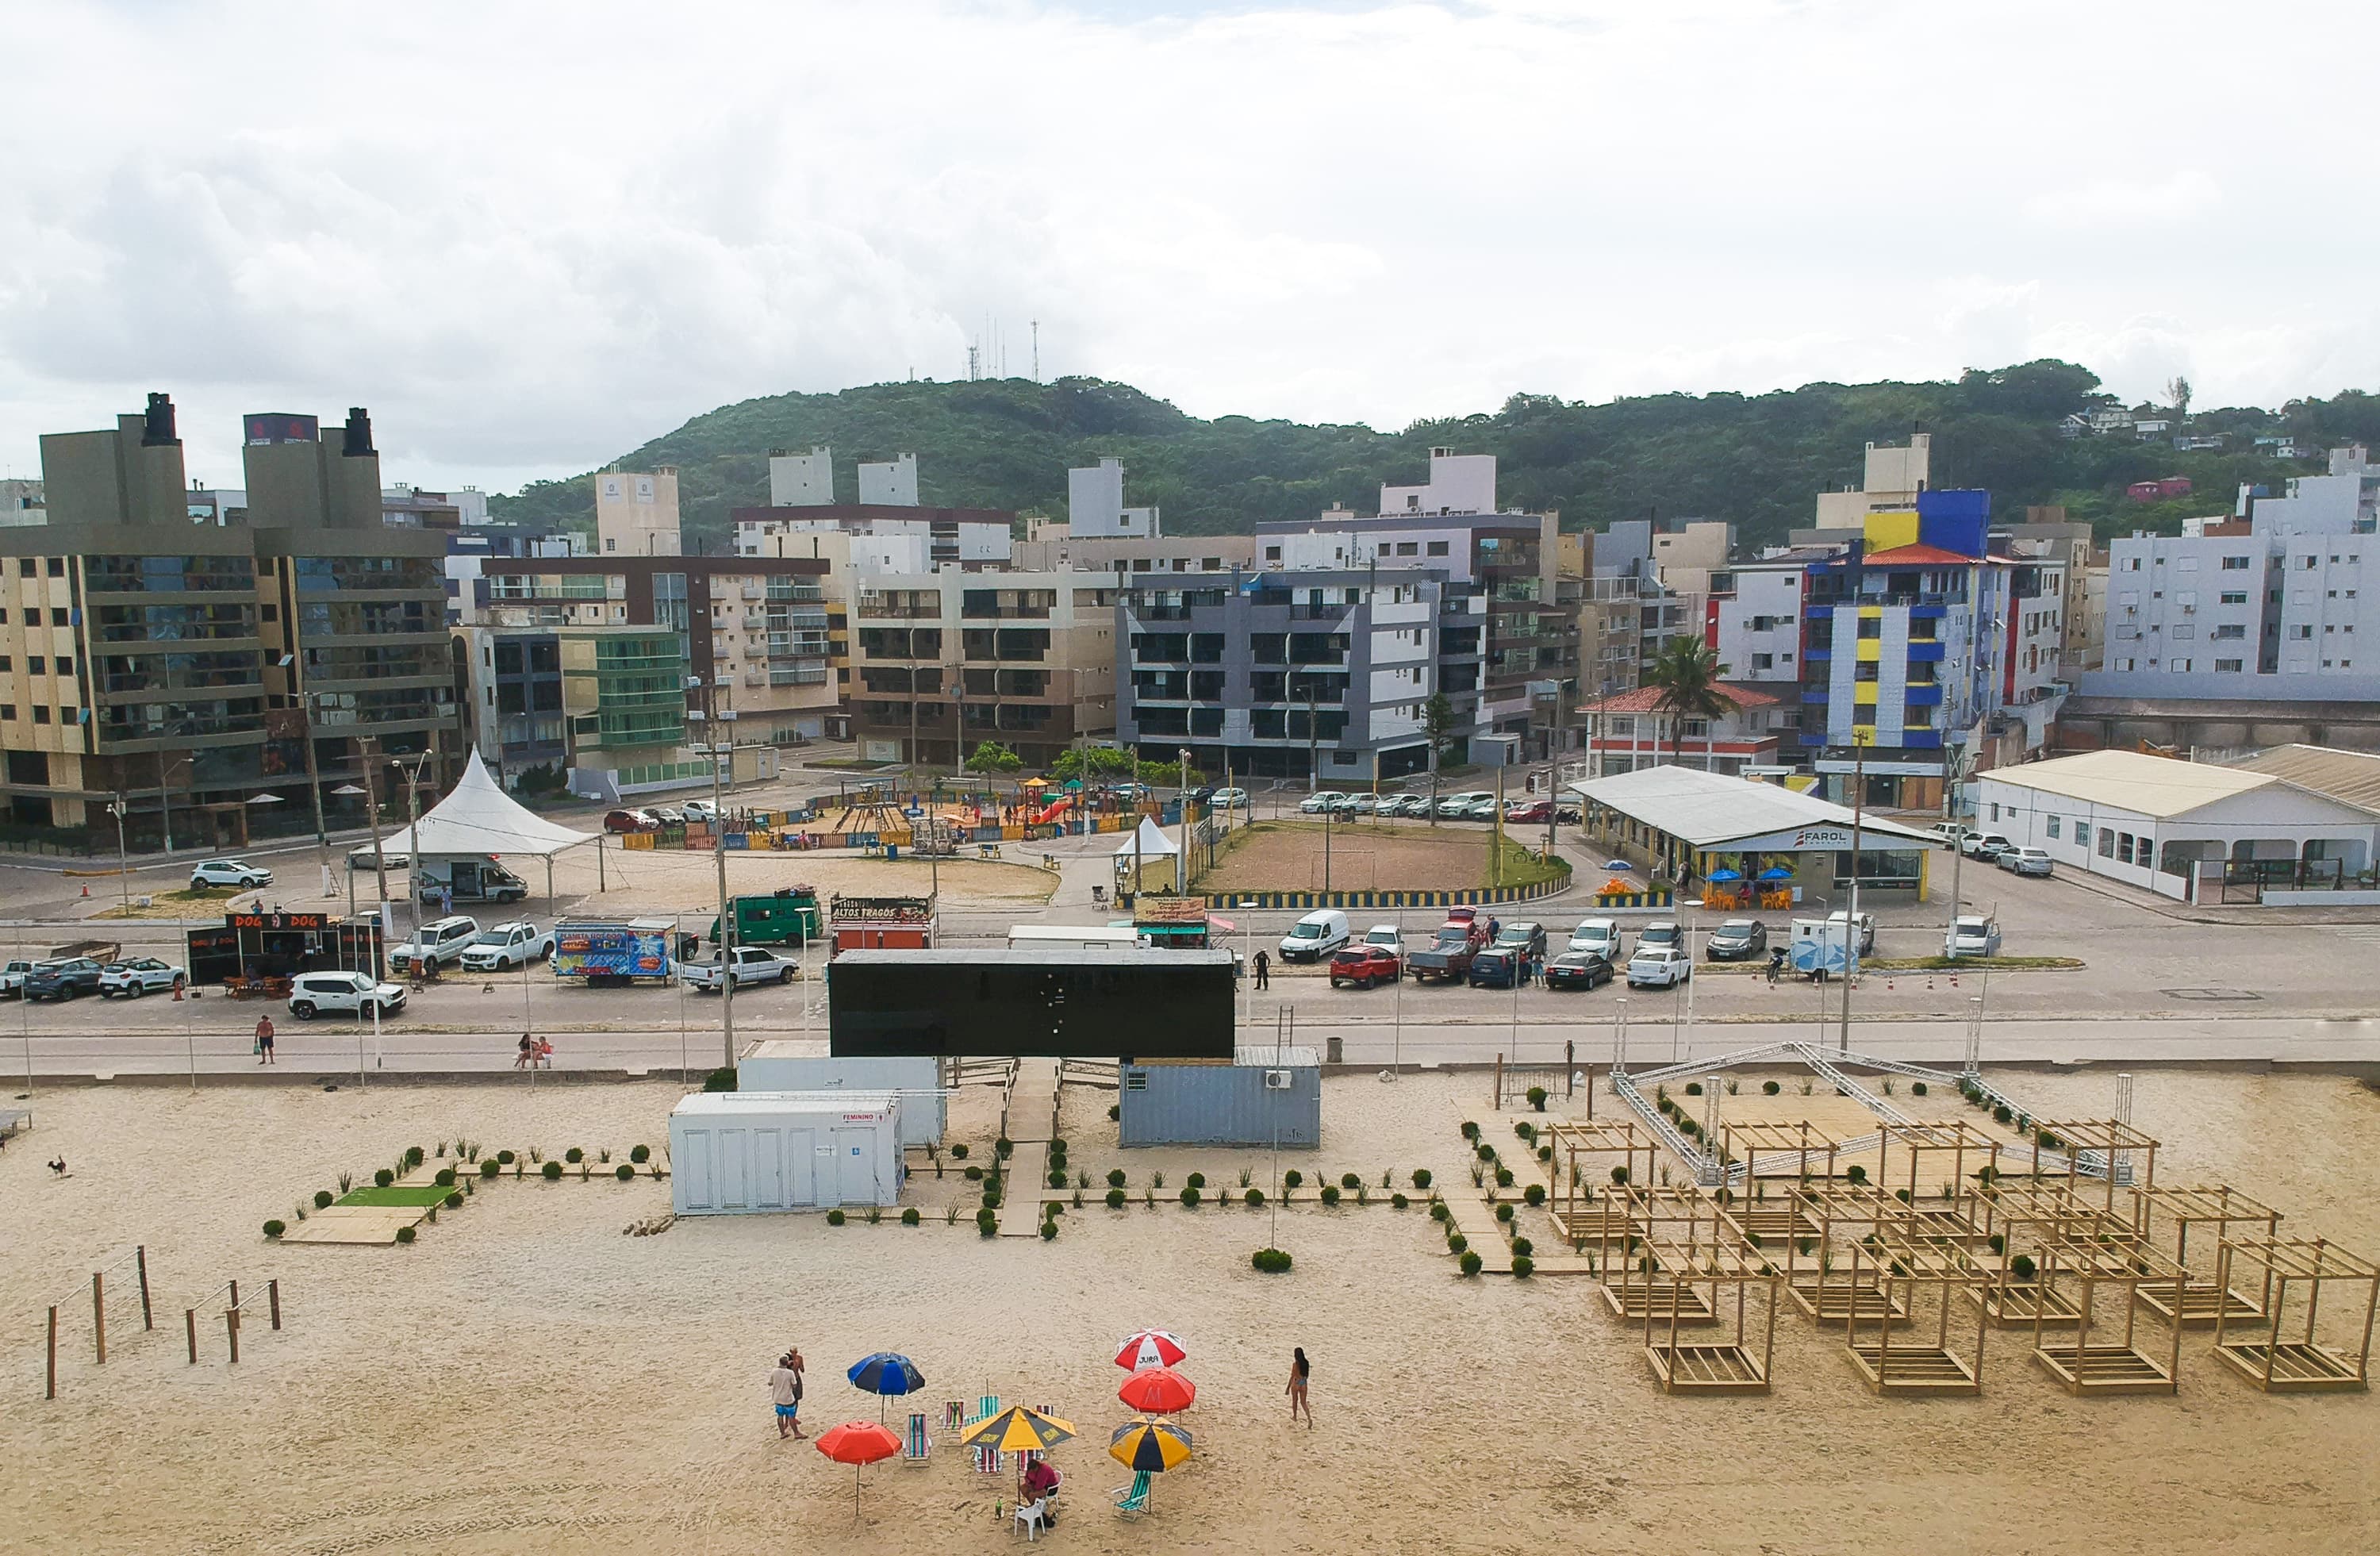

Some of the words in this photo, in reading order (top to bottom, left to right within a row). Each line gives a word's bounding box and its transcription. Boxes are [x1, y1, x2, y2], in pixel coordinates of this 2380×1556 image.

[832, 908, 860, 917] ALTOS
[235, 916, 263, 927] DOG
[290, 916, 318, 927] DOG
[1138, 1355, 1159, 1364] JURA
